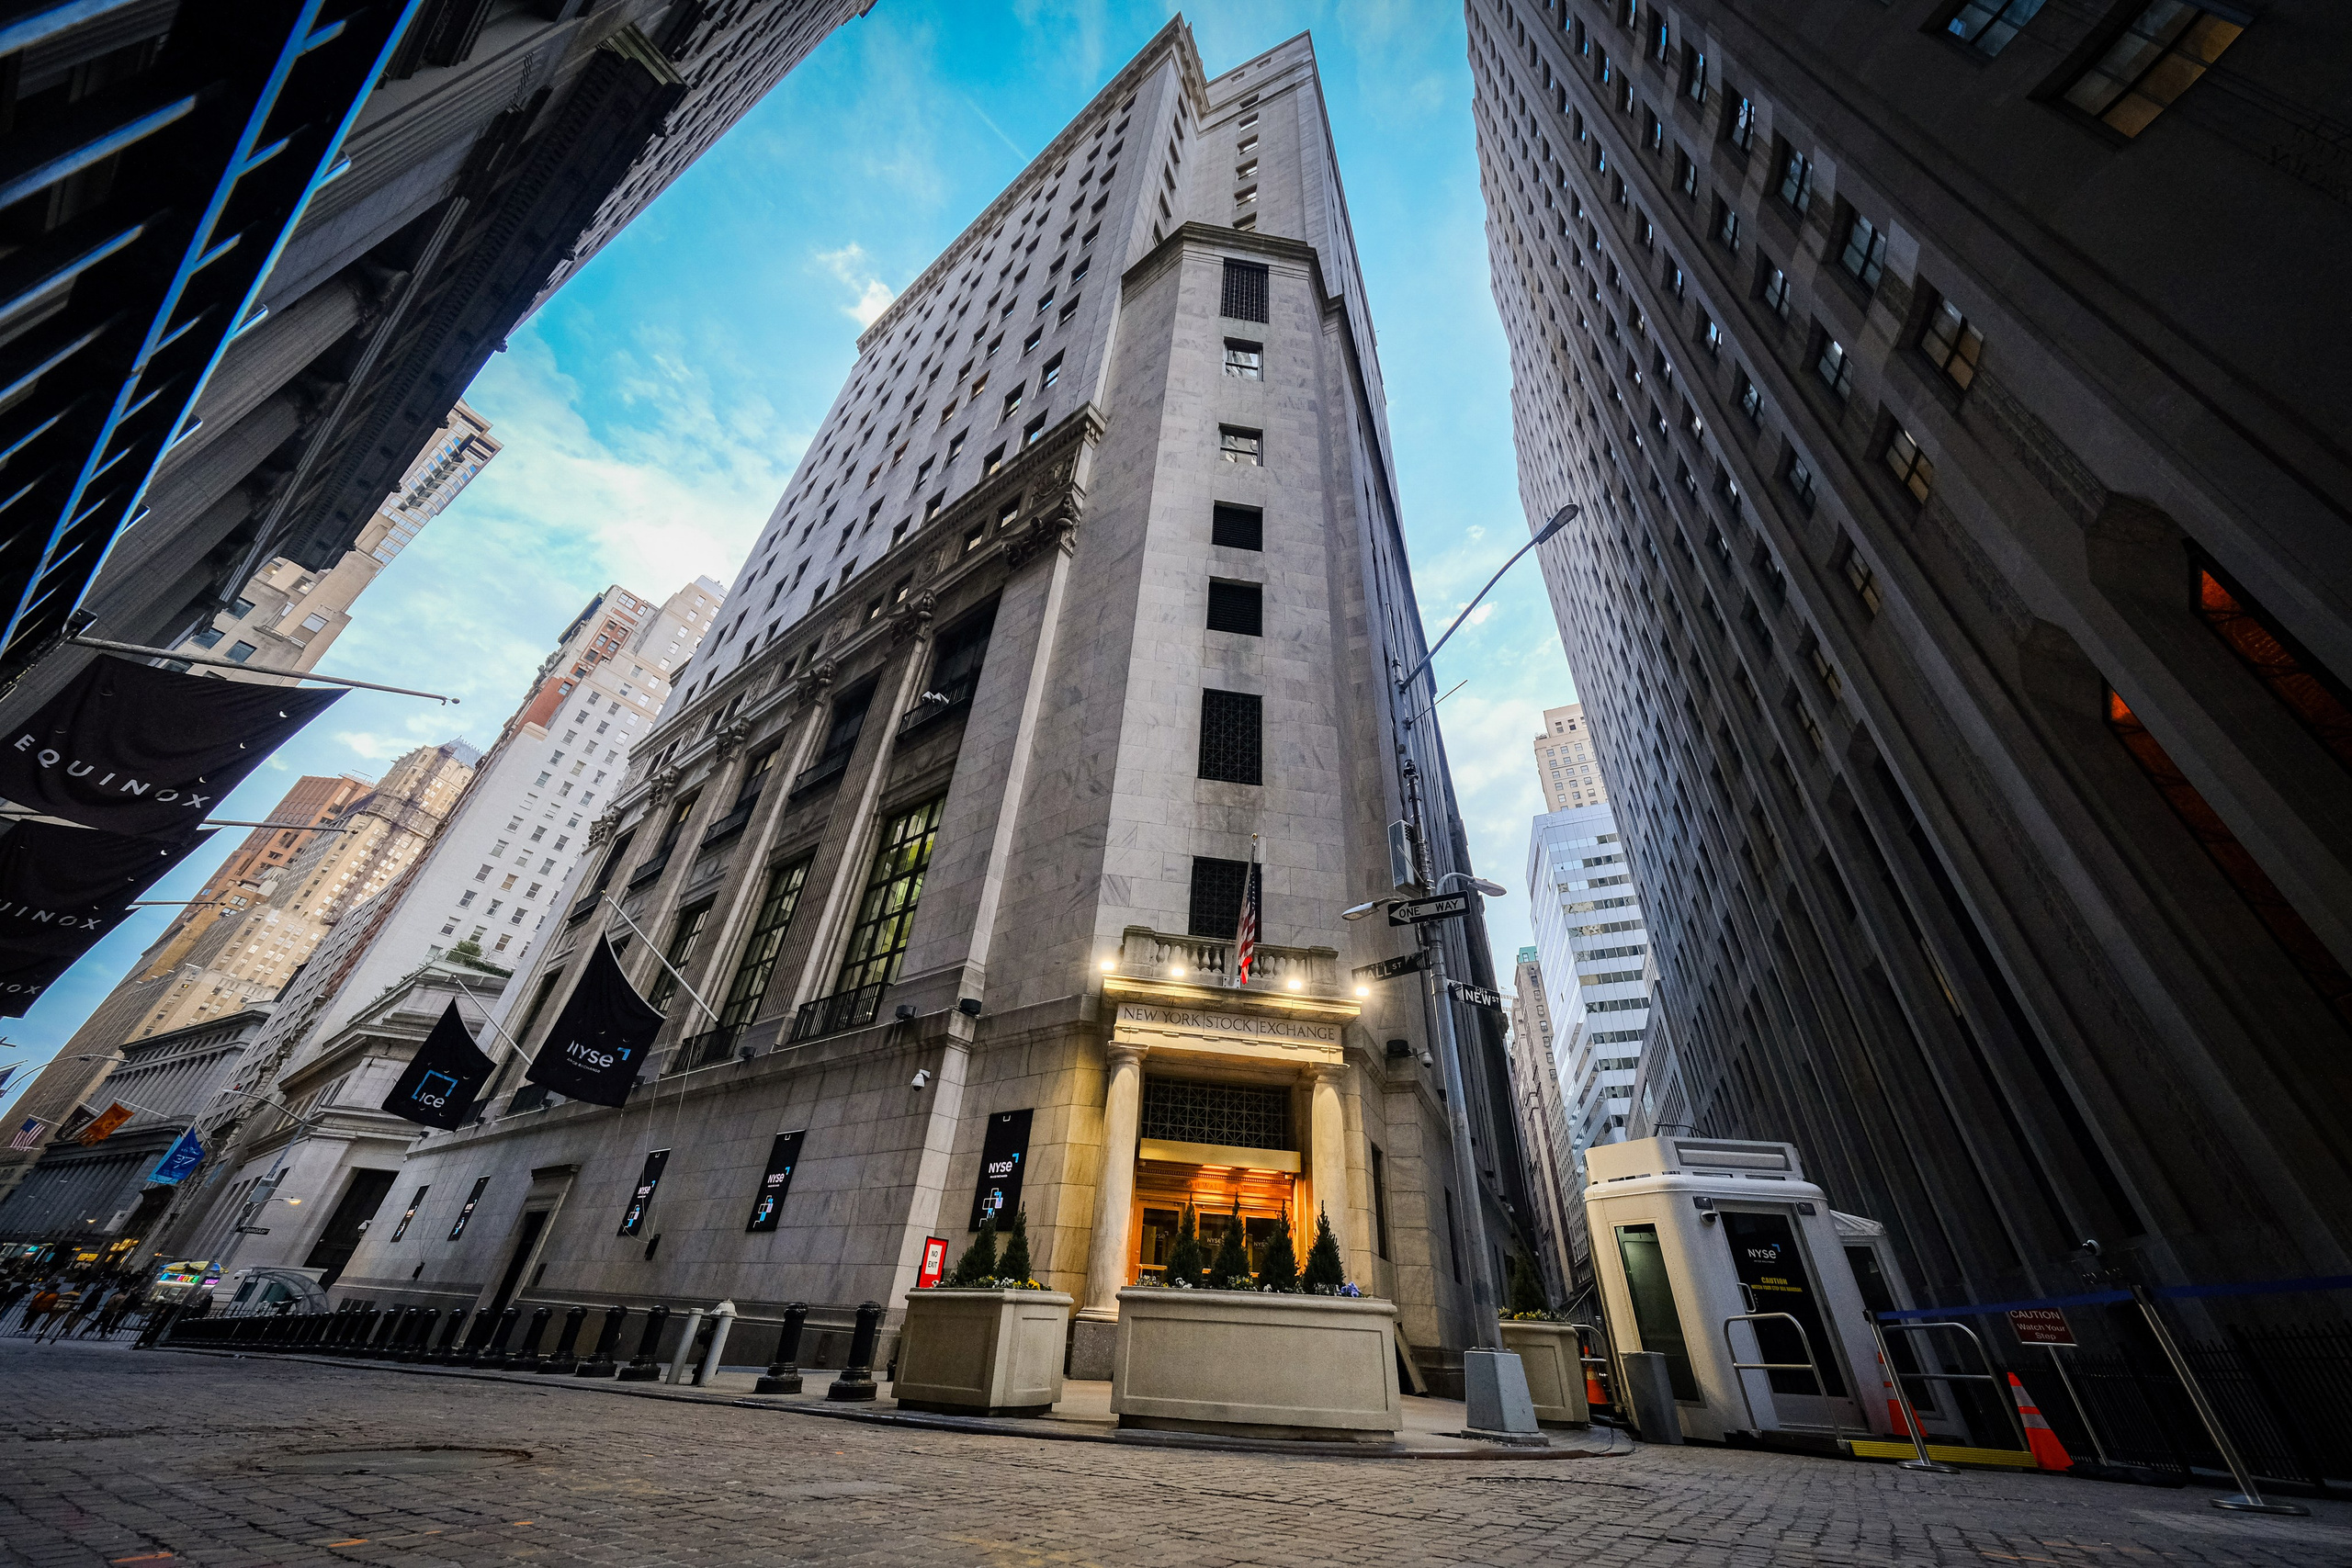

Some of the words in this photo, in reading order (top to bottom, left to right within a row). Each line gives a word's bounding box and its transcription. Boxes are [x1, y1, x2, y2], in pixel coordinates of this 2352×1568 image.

[14, 734, 210, 809] EQUINOX
[1398, 906, 1420, 919] ONE
[1434, 899, 1459, 912] WAY
[1355, 965, 1392, 981] WALL
[1392, 962, 1402, 970] ST
[1464, 988, 1491, 1006] NEW
[1124, 1007, 1158, 1021] NEW
[1162, 1010, 1201, 1027] YORK
[1205, 1015, 1252, 1032] STOCK
[1260, 1021, 1335, 1040] EXCHANGE
[1760, 1276, 1788, 1285] CAUTION
[2009, 1310, 2061, 1320] CAUTION
[2017, 1323, 2044, 1331] Watch
[2044, 1324, 2065, 1332] Your
[2035, 1332, 2056, 1340] Step
